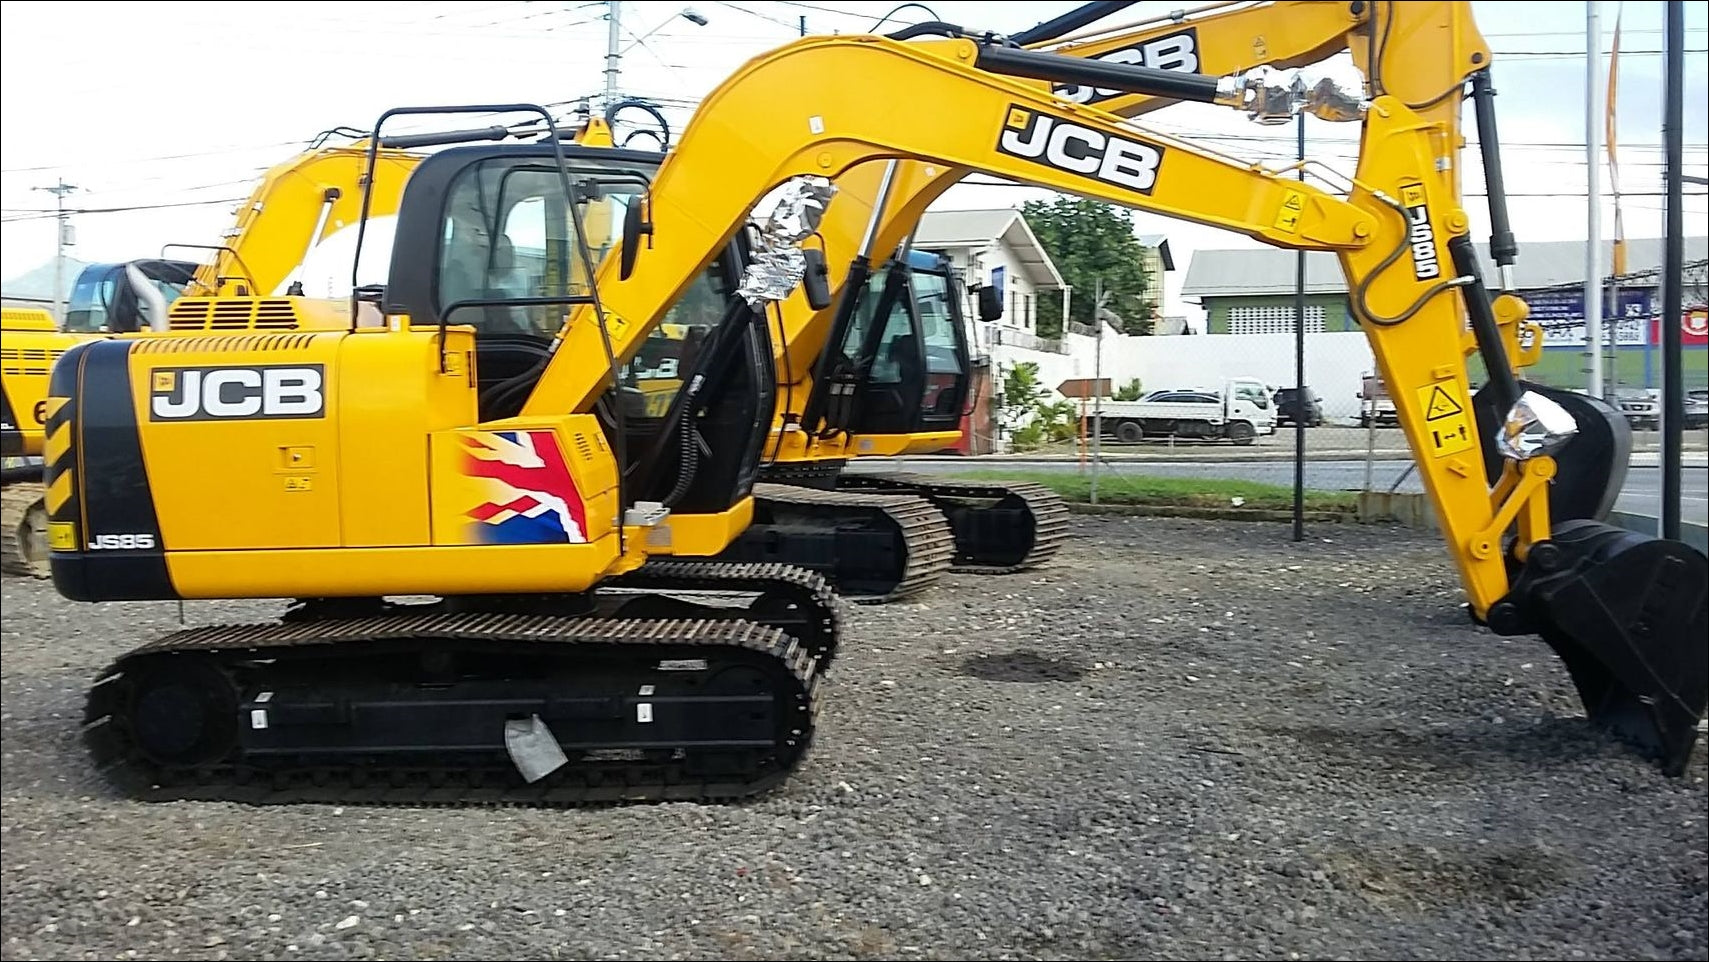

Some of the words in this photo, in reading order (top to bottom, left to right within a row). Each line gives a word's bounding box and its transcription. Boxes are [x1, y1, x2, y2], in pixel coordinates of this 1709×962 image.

[1001, 115, 1160, 190] JCB
[1410, 206, 1439, 278] JS85
[152, 369, 322, 418] JCB
[88, 534, 155, 550] JS85
